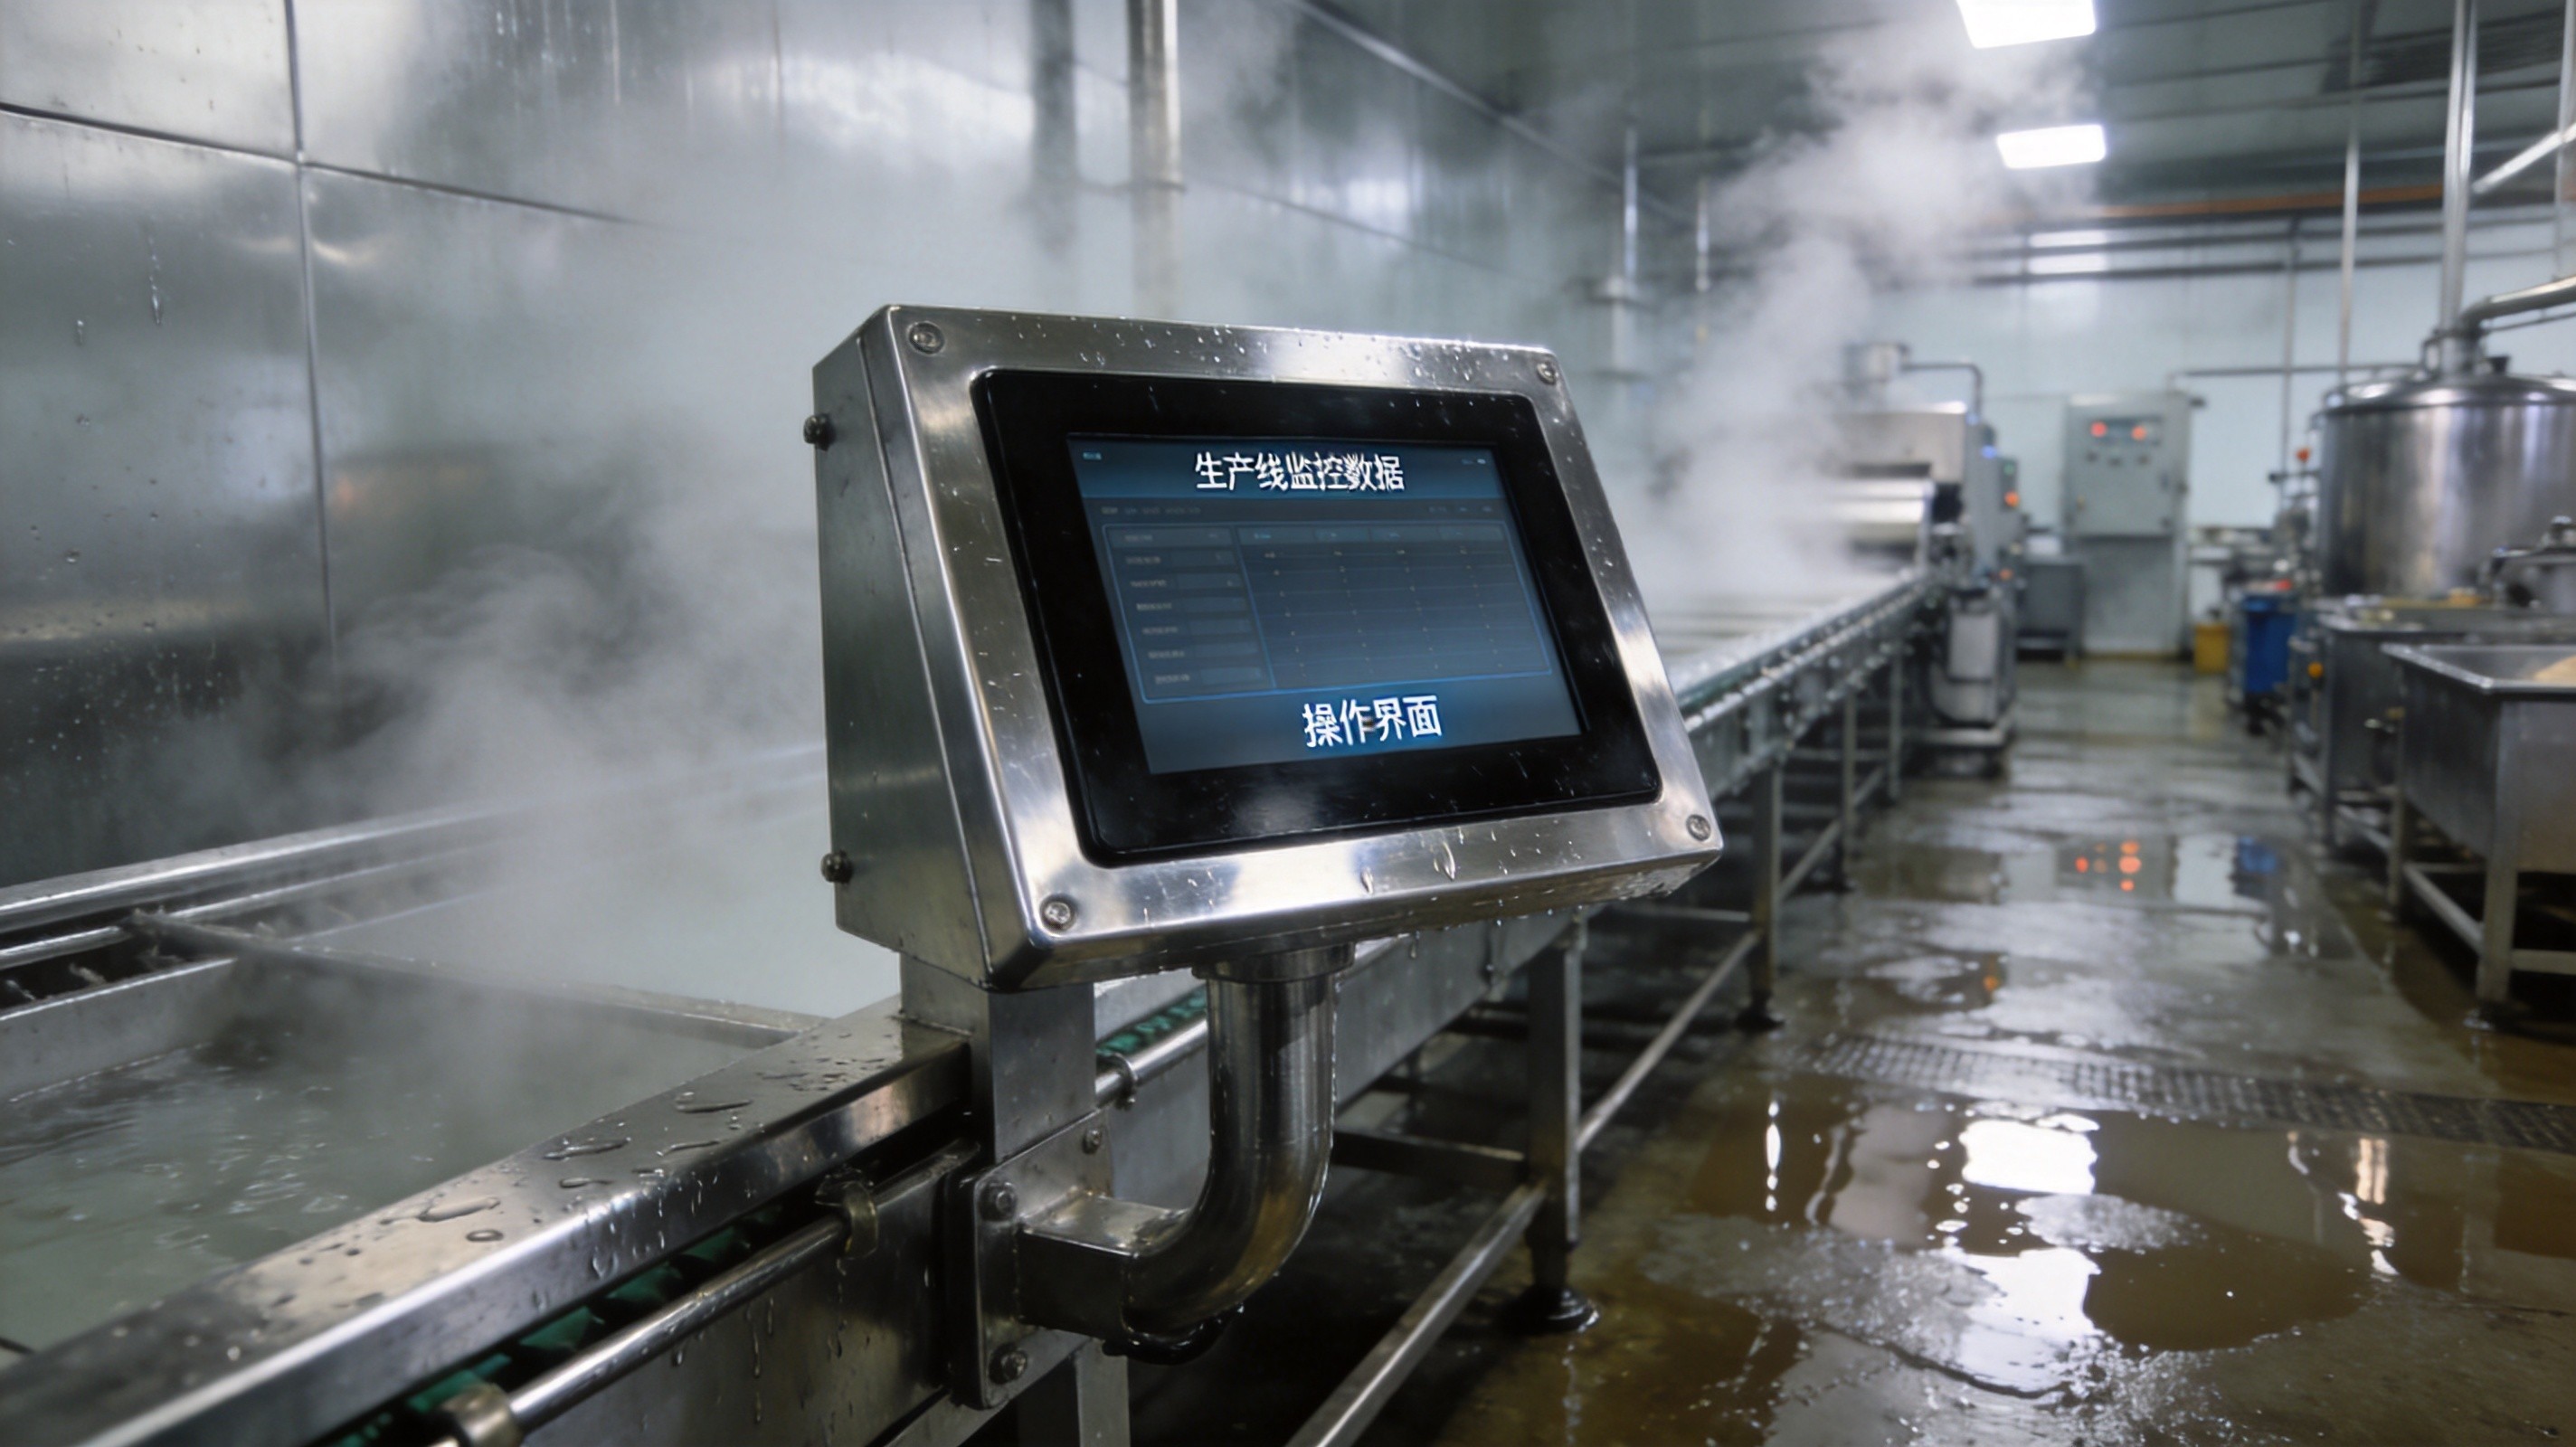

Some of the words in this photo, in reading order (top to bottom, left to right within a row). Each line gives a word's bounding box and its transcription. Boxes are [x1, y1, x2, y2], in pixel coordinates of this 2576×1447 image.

[1195, 451, 1406, 491] 生产线监控数据
[1302, 695, 1442, 748] 操作界面
